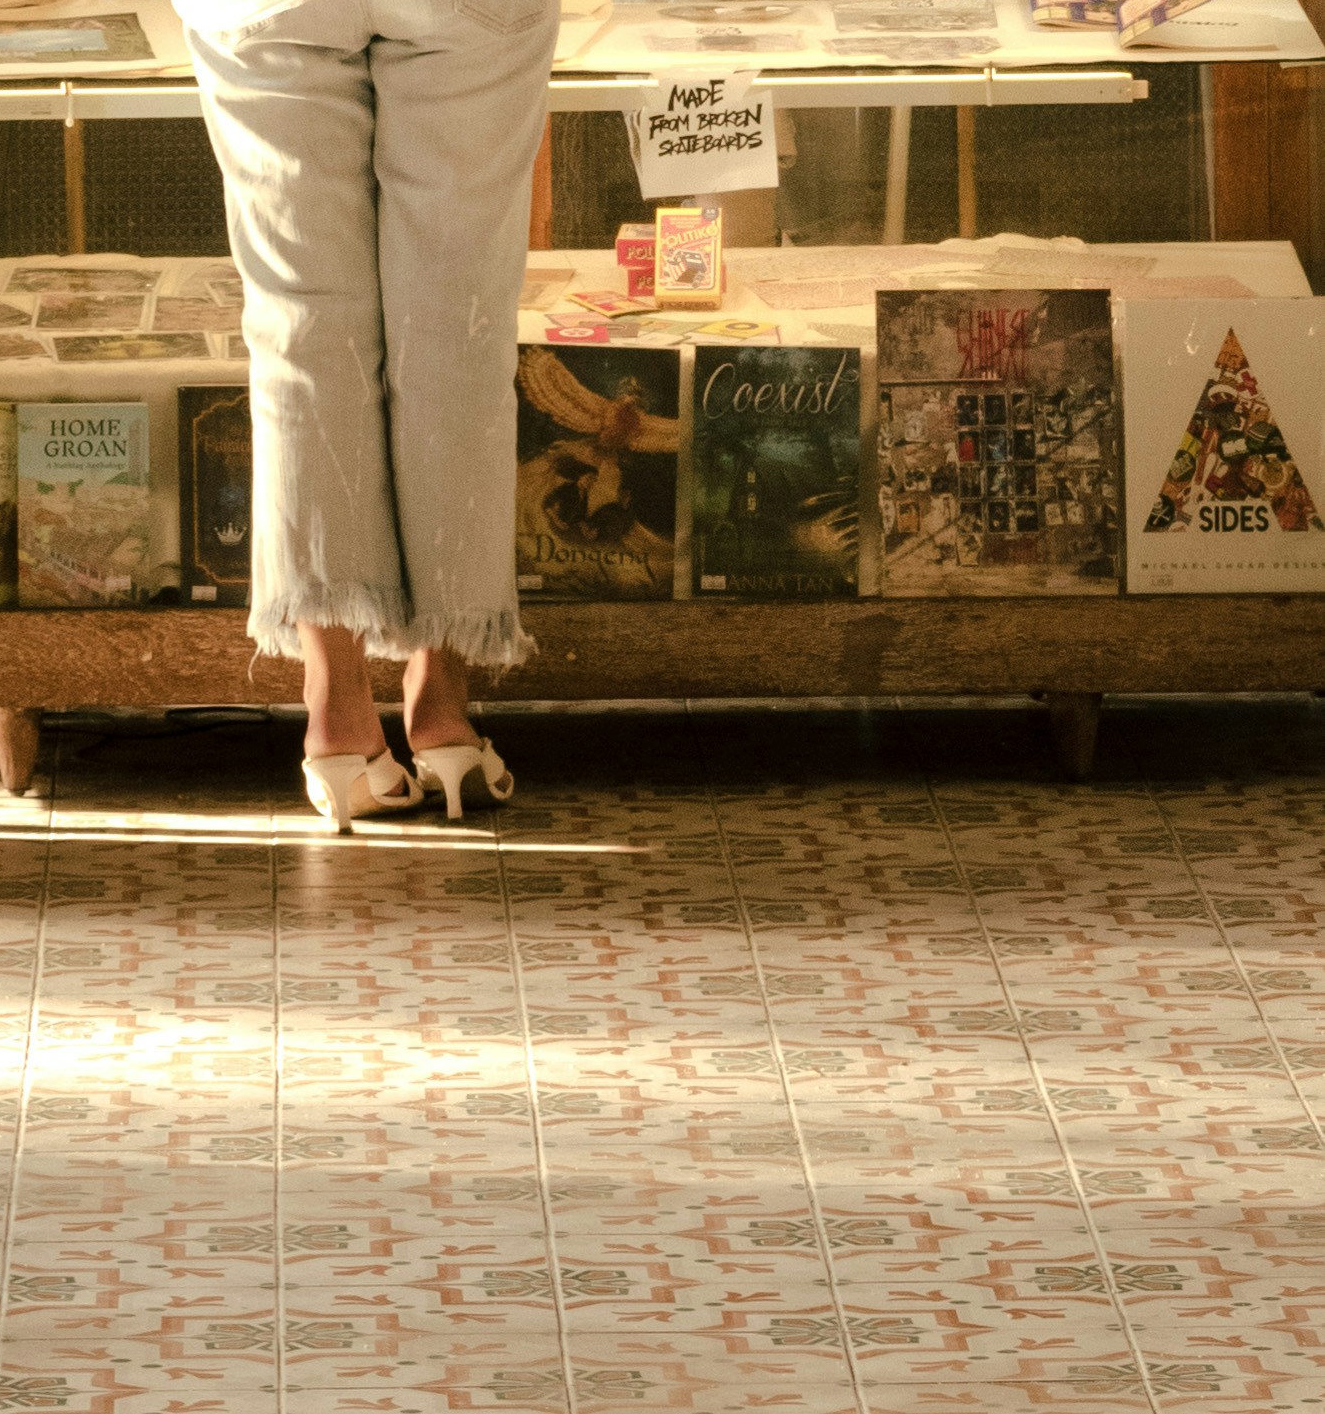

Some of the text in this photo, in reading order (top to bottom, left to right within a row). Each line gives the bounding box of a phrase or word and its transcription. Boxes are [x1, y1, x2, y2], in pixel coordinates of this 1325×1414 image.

[667, 78, 726, 112] MADE
[649, 103, 763, 141] FROM BROKEN
[658, 131, 763, 157] SKATEBOARDS
[703, 353, 860, 420] Coexist
[49, 419, 121, 437] HOME
[44, 439, 127, 458] GROAN
[1198, 505, 1270, 533] SIDES
[1141, 562, 1207, 570] MICHAEL
[726, 574, 834, 592] ANNA TAN
